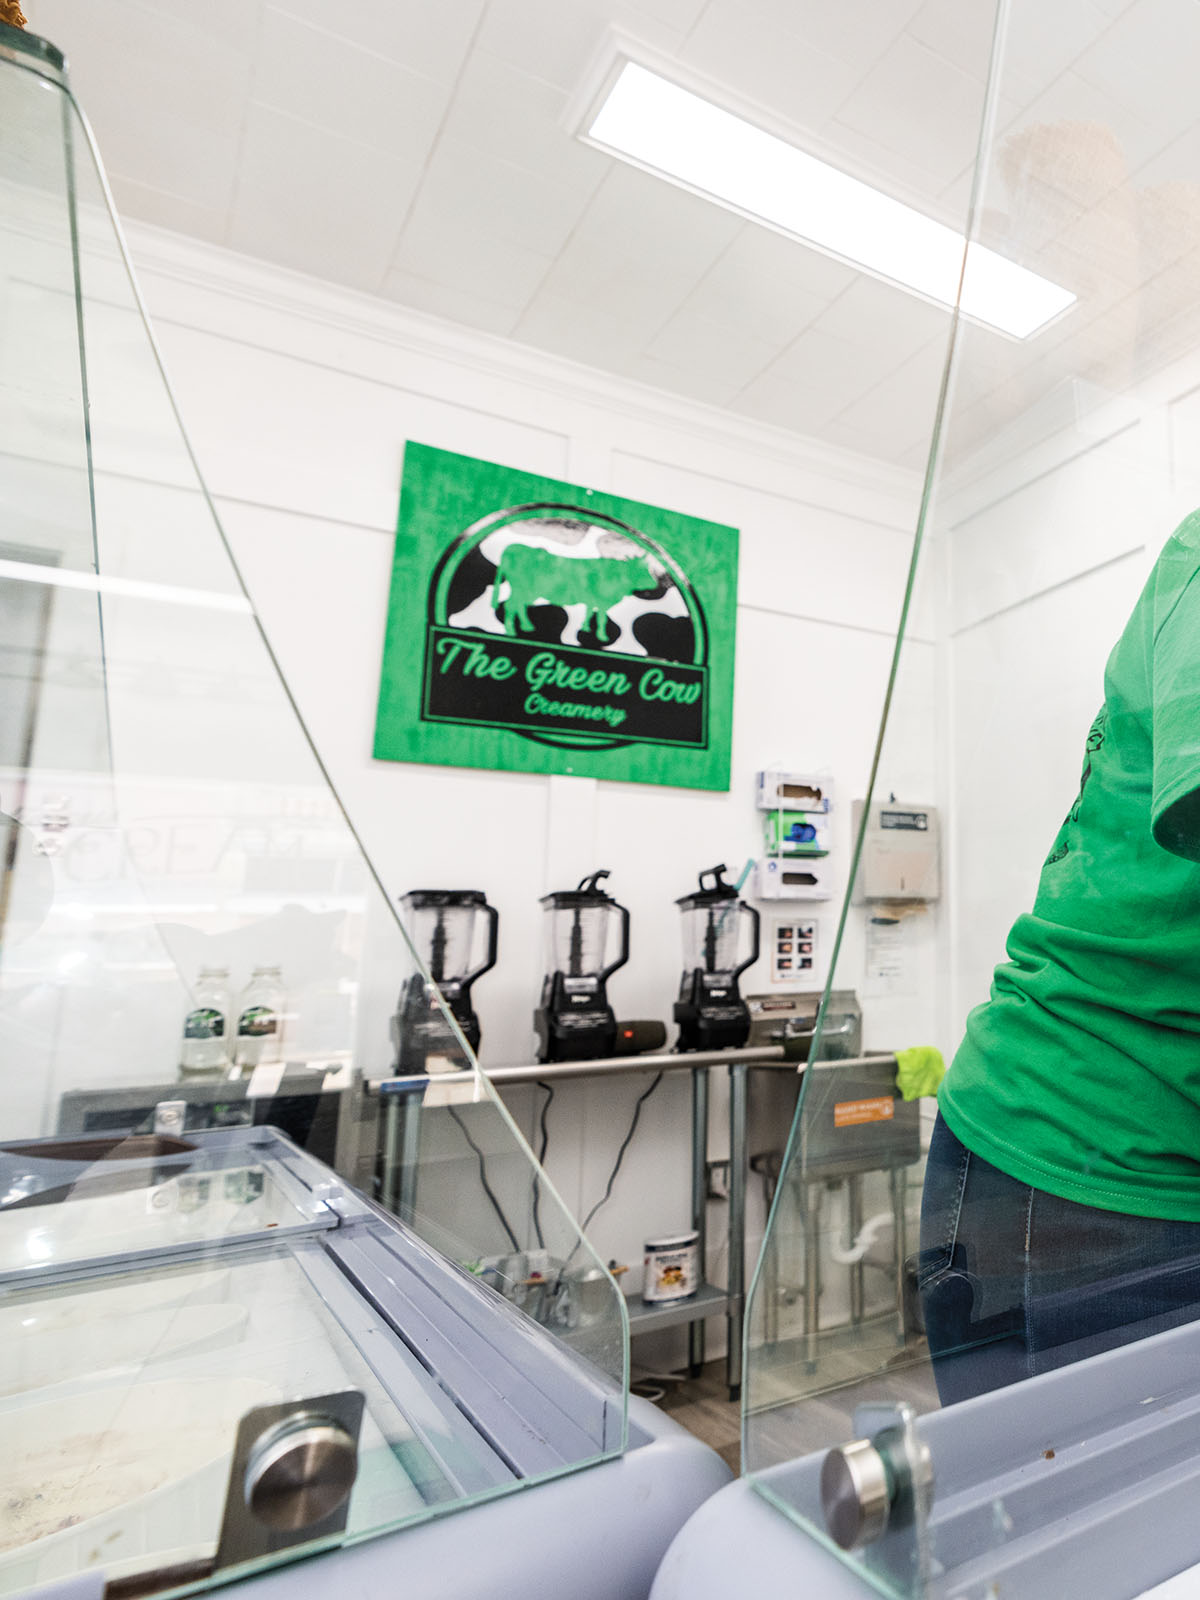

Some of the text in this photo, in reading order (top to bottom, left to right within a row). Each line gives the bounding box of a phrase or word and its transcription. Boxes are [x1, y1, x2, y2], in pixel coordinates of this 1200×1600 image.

[437, 637, 702, 704] The Green Cow
[524, 693, 627, 728] Creamery
